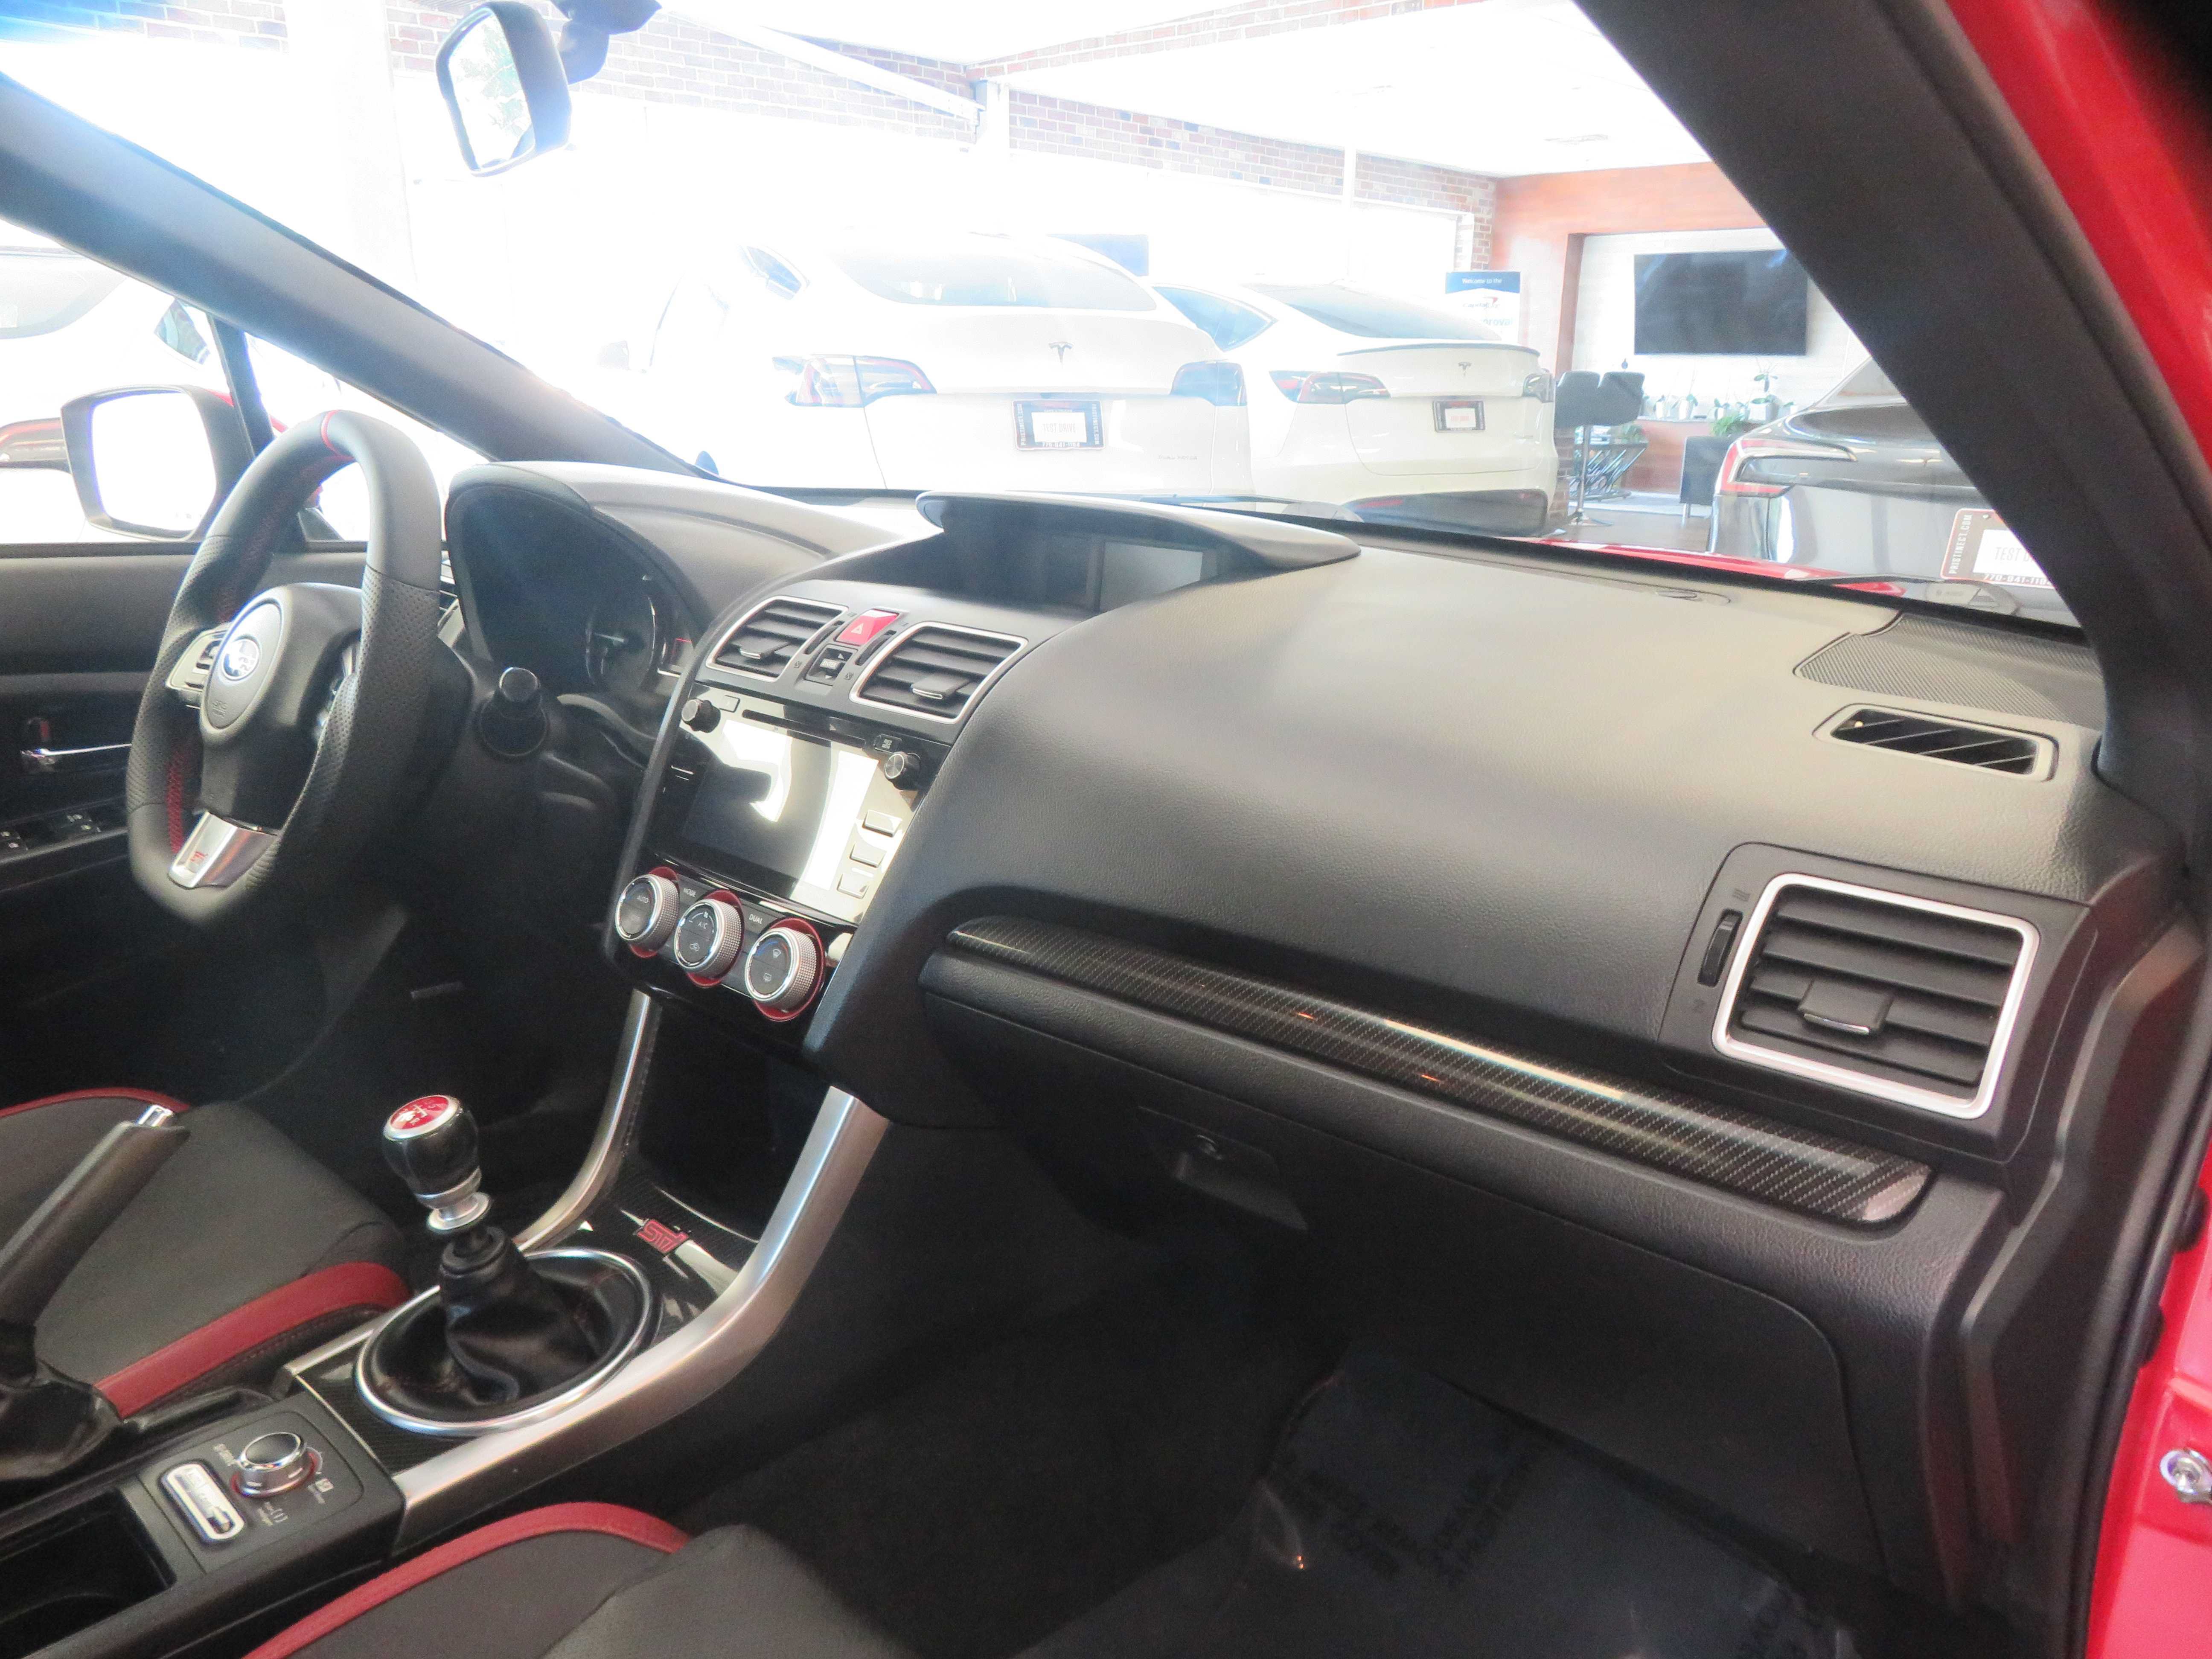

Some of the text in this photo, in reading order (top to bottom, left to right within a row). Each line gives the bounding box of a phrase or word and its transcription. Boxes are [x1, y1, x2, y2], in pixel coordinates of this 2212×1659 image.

[1042, 423, 1076, 433] TEST DRIVE
[1994, 547, 2022, 562] TEST
[684, 888, 697, 897] MODE
[637, 895, 649, 904] AUTO
[748, 913, 763, 925] DUAL
